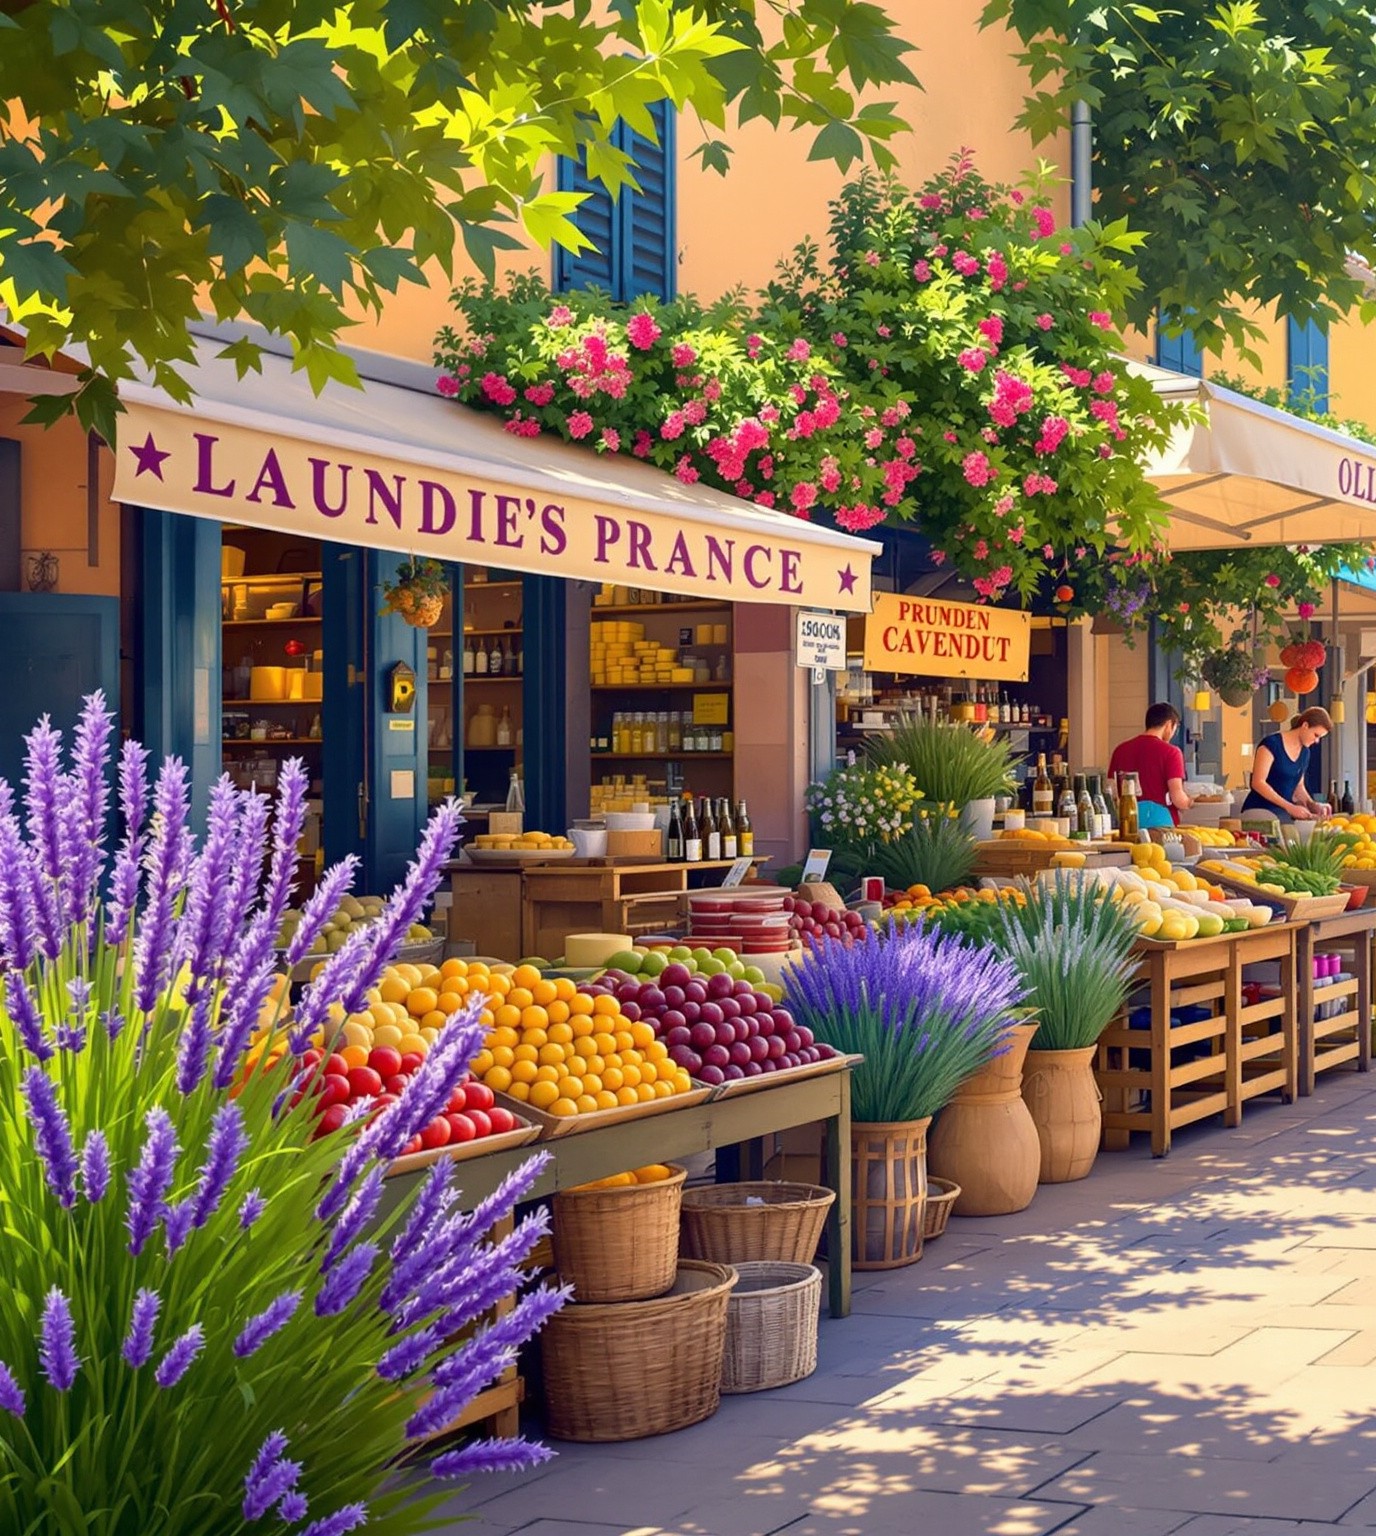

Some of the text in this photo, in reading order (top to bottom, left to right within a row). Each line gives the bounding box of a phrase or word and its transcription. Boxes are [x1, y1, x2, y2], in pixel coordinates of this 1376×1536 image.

[193, 432, 804, 594] LAUNDIE'S PRANCE
[899, 602, 990, 630] PRUNDEN
[882, 626, 1011, 662] CAVENDUT
